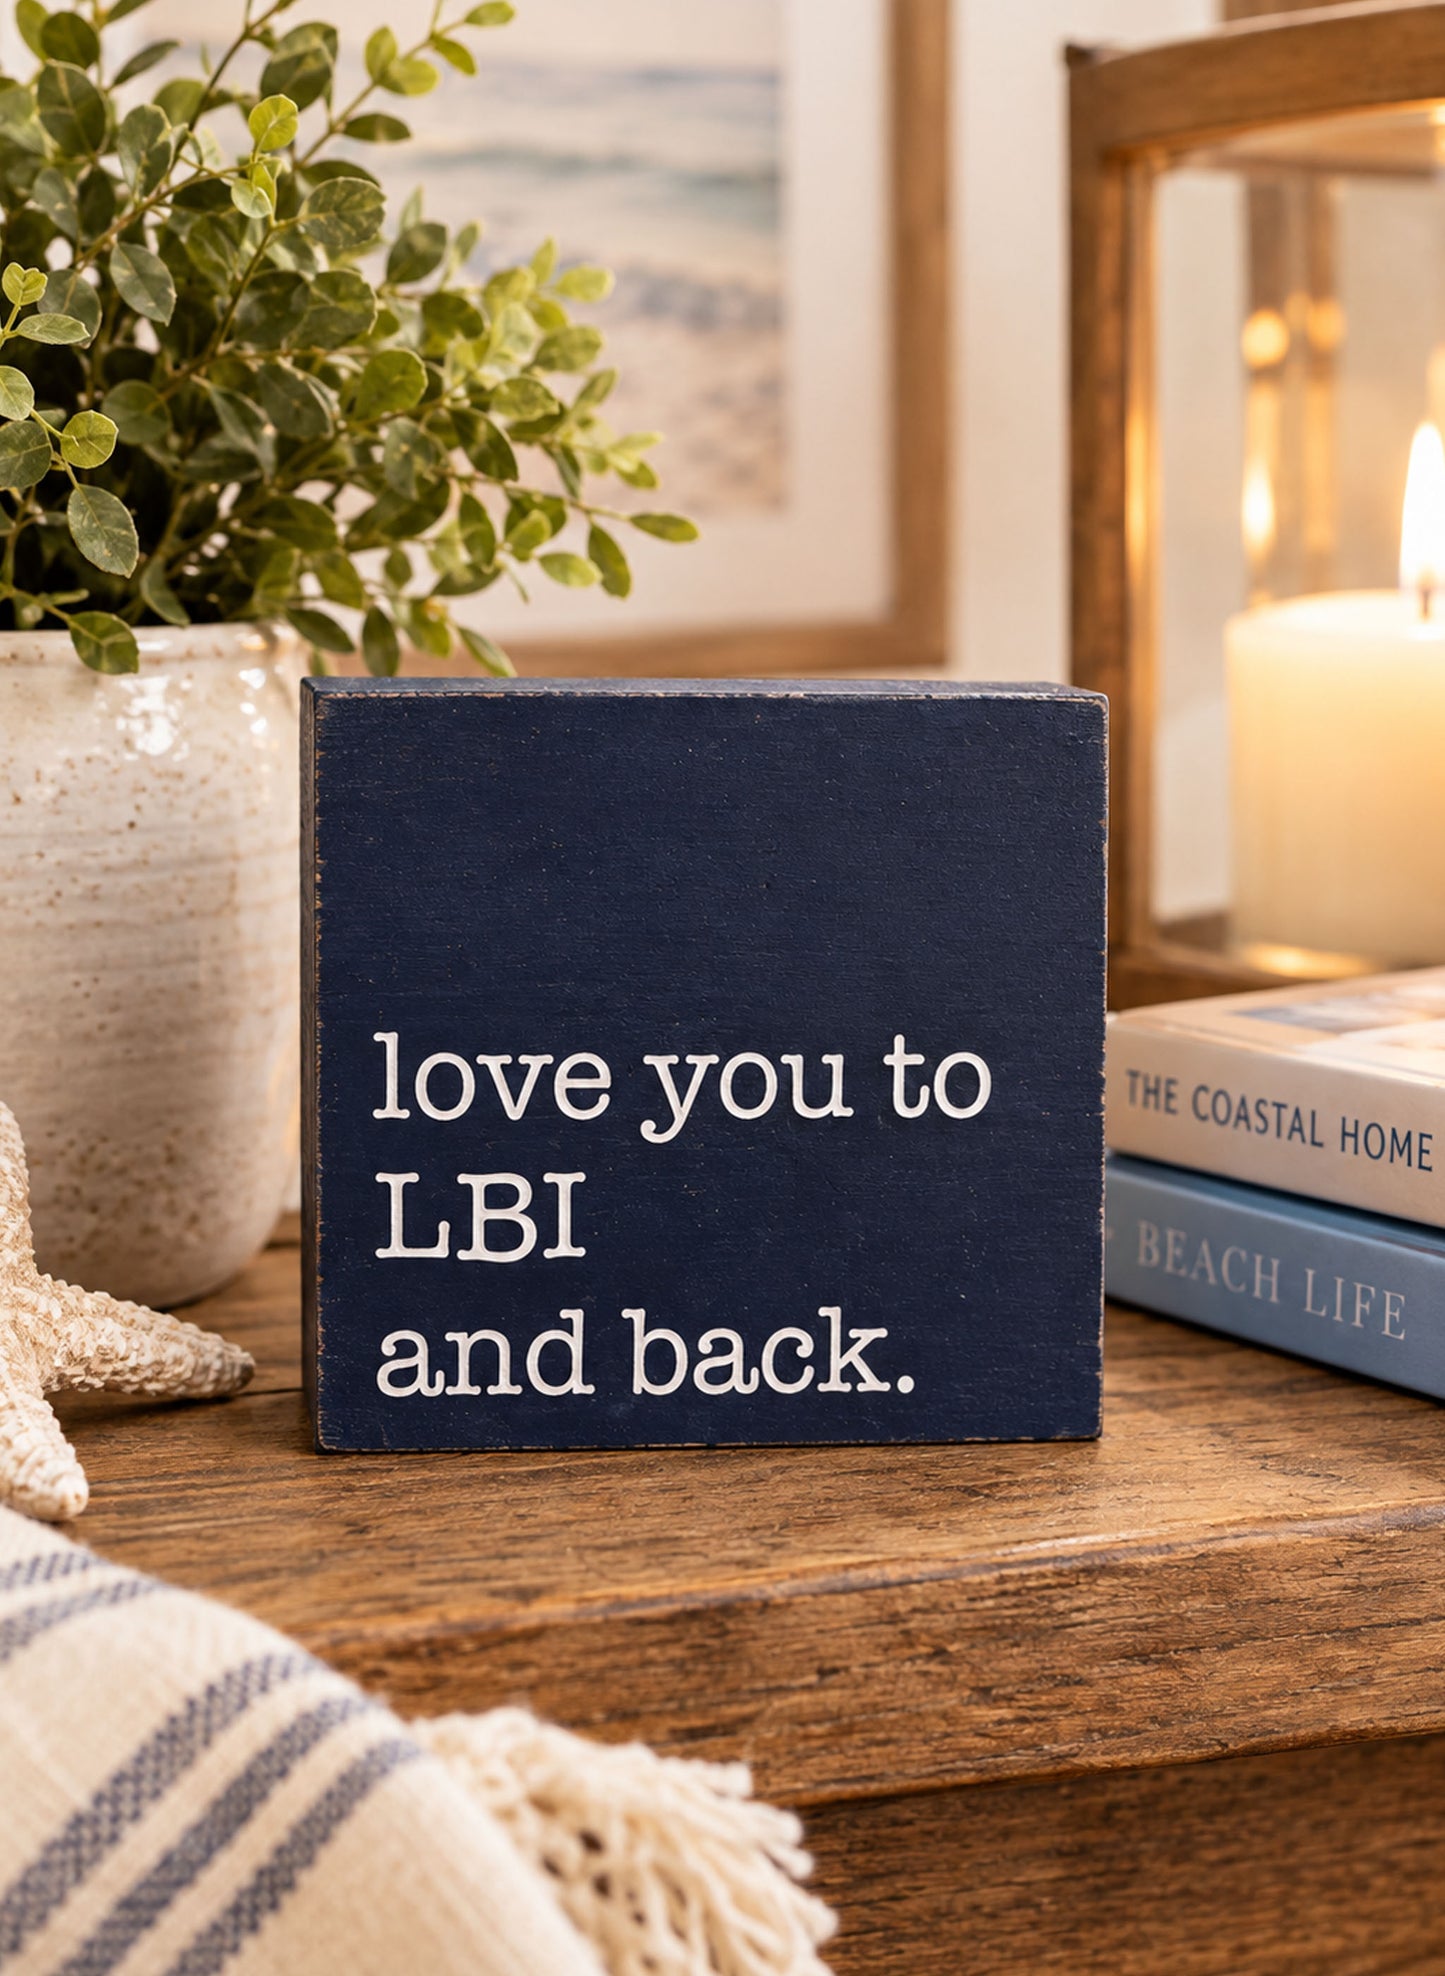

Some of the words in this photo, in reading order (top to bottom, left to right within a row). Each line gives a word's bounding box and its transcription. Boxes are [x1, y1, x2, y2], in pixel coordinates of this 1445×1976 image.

[372, 1031, 612, 1122] love
[640, 1051, 855, 1144] you
[883, 1034, 992, 1120] to
[1126, 1068, 1179, 1115] THE
[1192, 1083, 1324, 1148] COASTAL
[1340, 1116, 1433, 1172] HOME
[375, 1171, 587, 1263] LBI
[1137, 1219, 1280, 1304] BEACH
[1303, 1268, 1405, 1341] LIFE
[376, 1308, 596, 1398] and
[621, 1306, 915, 1396] back.
